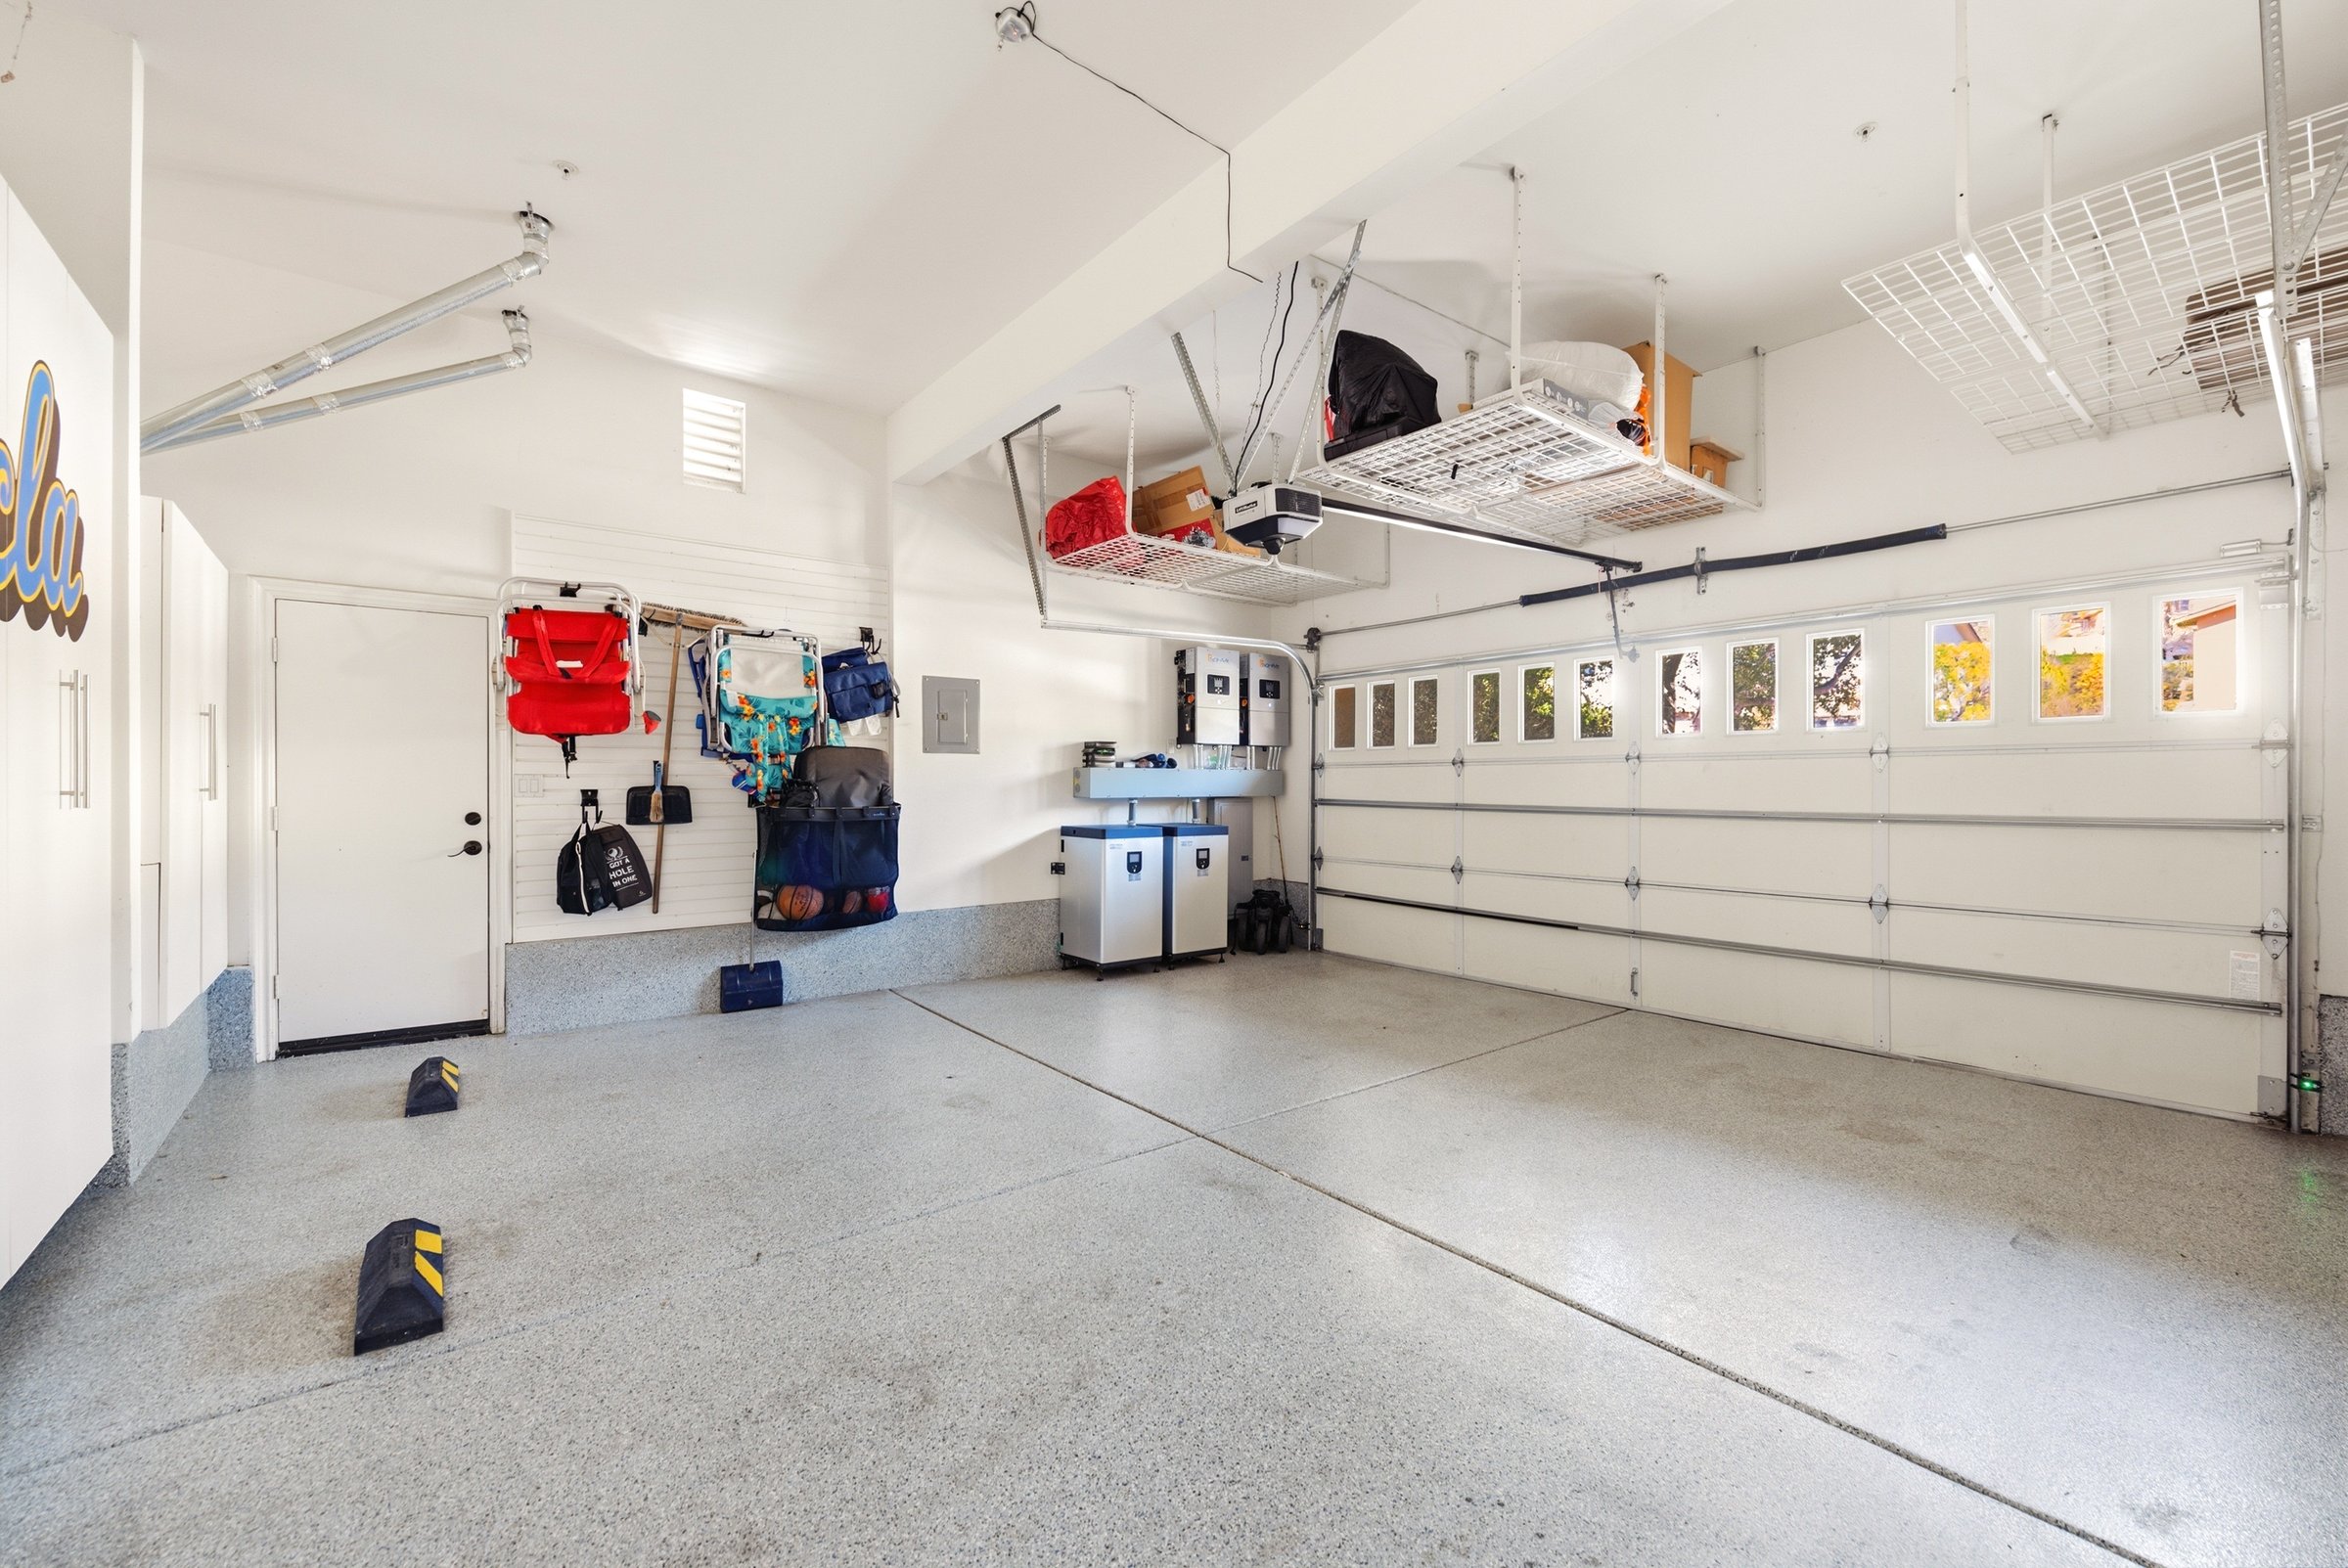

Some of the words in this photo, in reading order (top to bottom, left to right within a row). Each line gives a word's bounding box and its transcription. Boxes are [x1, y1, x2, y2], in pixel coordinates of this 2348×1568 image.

[609, 860, 623, 870] GOT
[609, 865, 635, 879] HOLE
[621, 874, 638, 884] ONE
